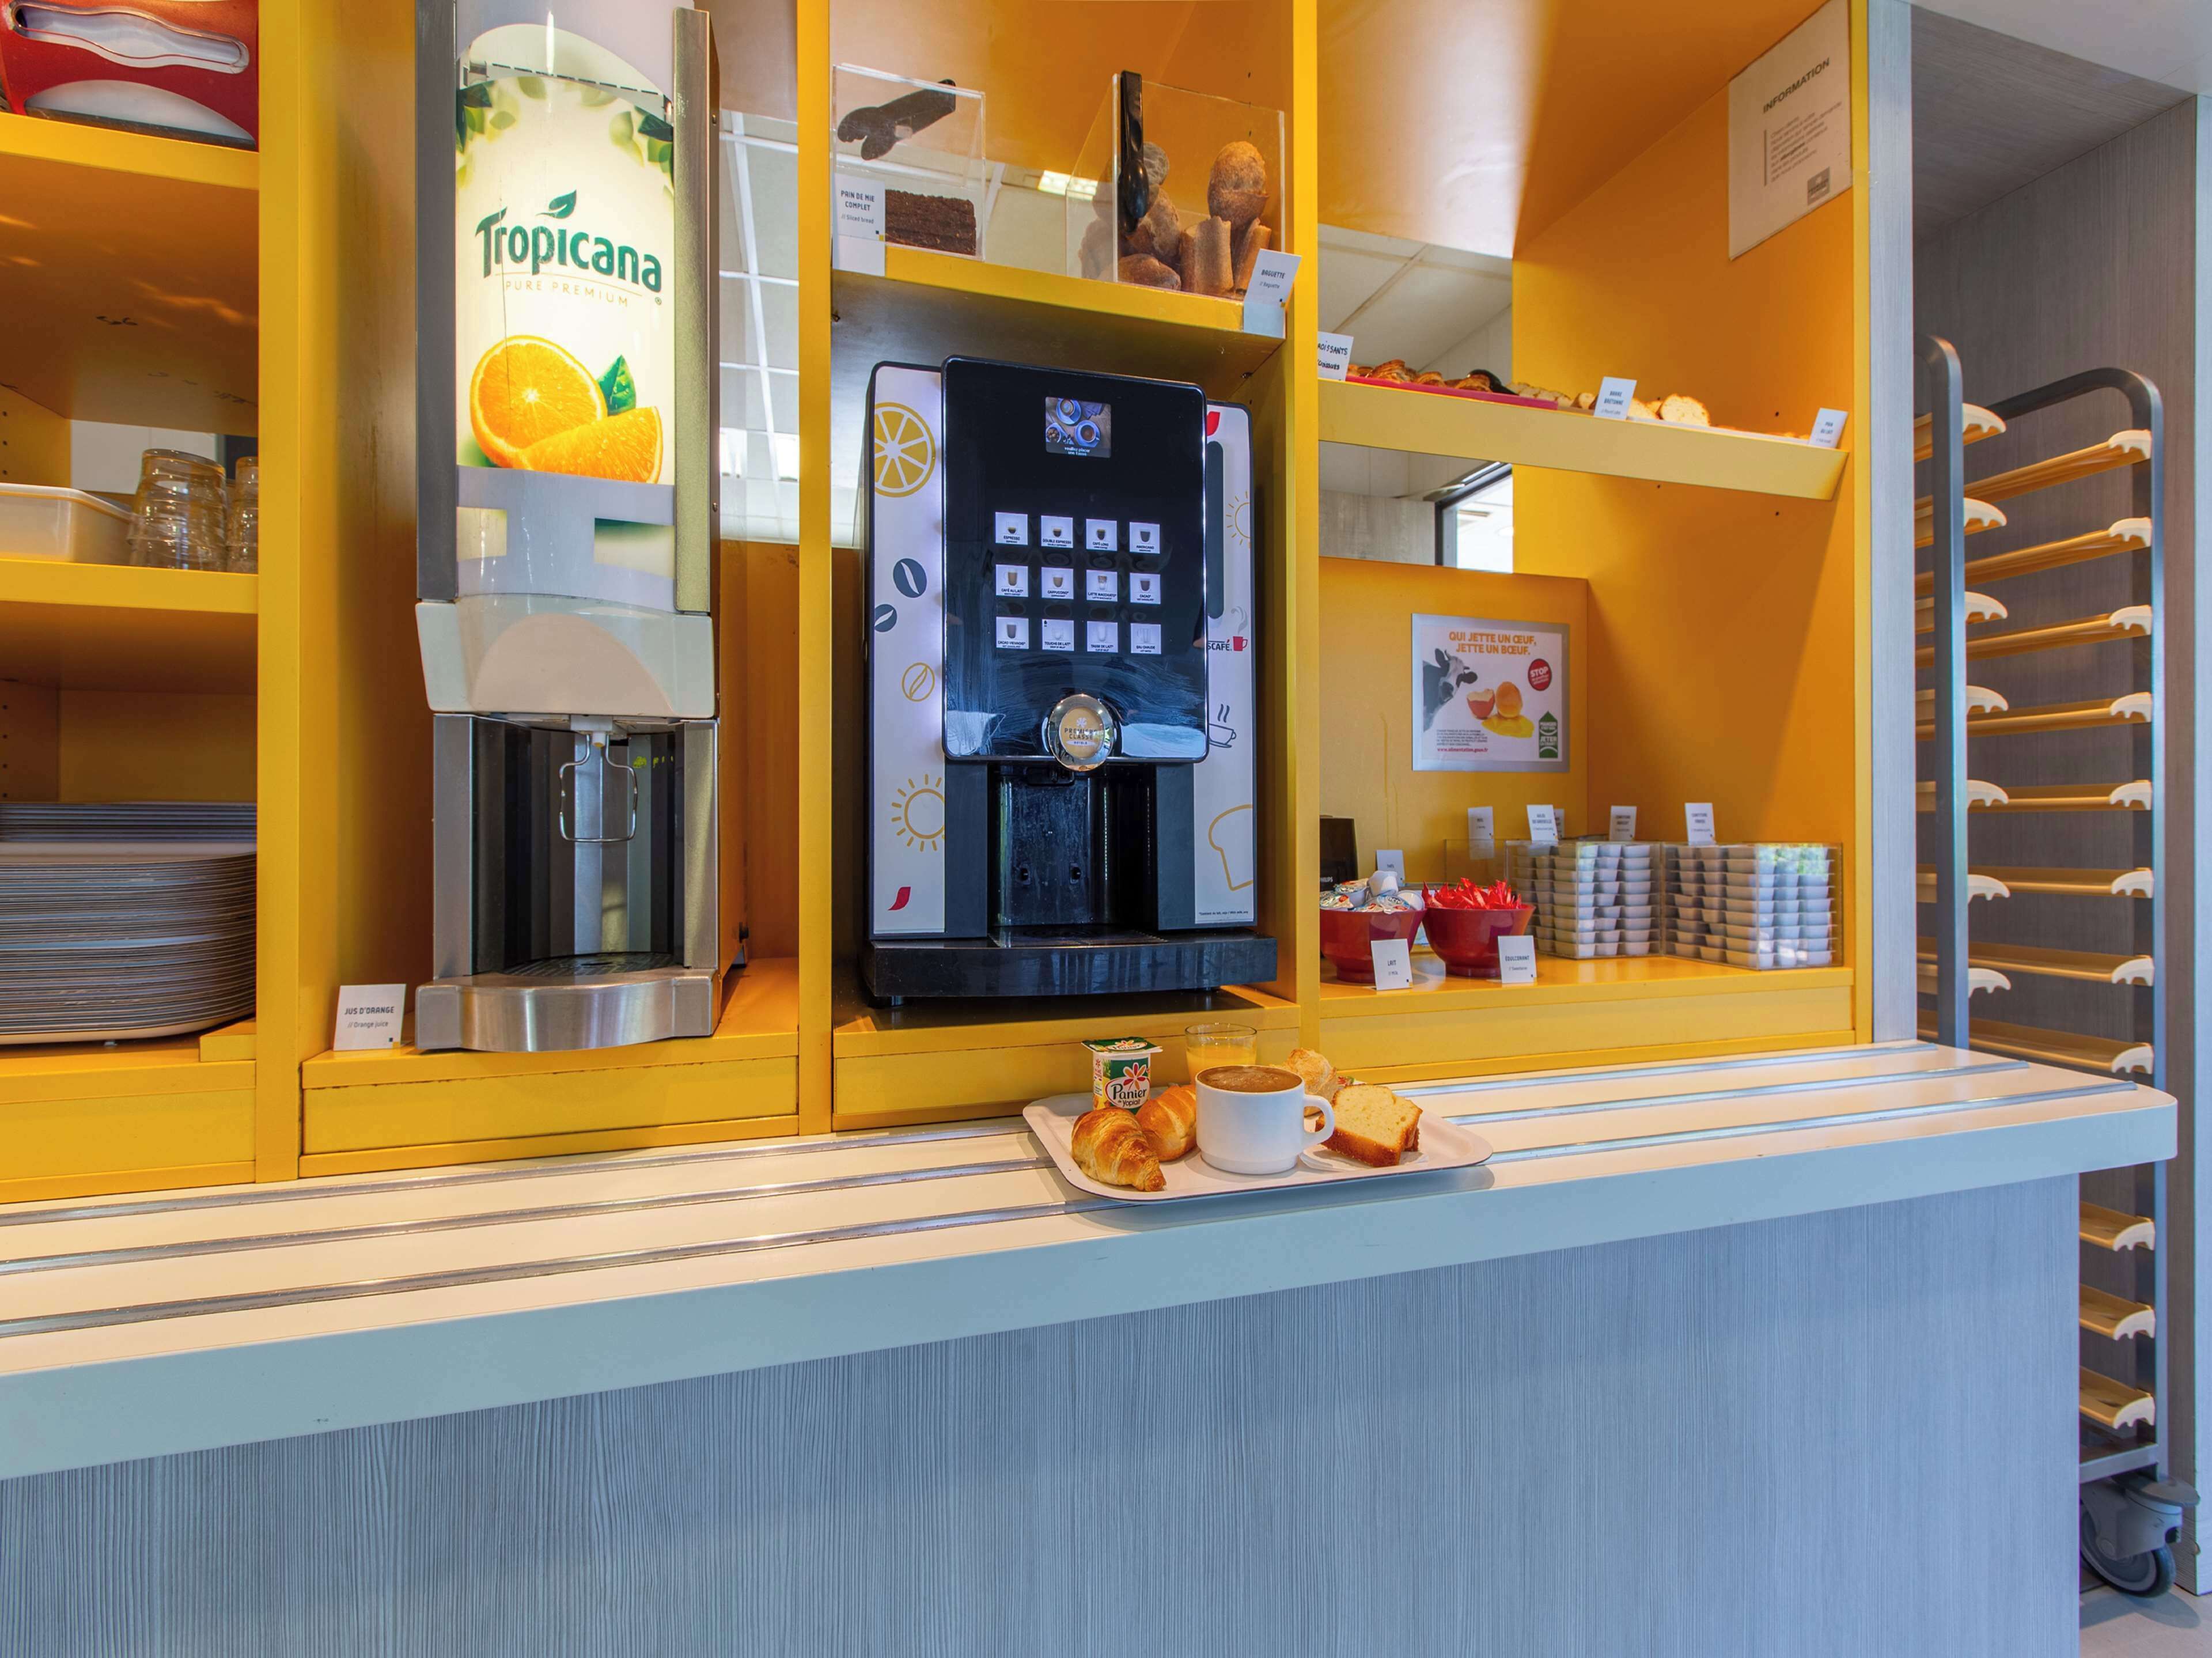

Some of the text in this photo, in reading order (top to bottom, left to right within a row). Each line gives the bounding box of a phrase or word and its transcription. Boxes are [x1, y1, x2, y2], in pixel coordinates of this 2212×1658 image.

[1763, 57, 1830, 113] INFORMATION
[841, 190, 875, 202] PAIN DE MIE
[845, 201, 870, 211] COMPLET
[475, 206, 661, 293] Tropicana
[1262, 269, 1285, 279] BAGUETTE
[505, 281, 628, 307] PURE PREMIUM
[1318, 340, 1348, 355] ROISSANTS
[1449, 631, 1465, 641] QUI
[1468, 632, 1495, 642] JETTE
[1498, 634, 1510, 643] UN
[1456, 643, 1530, 655] JETTE UN BŒUF.
[1531, 666, 1548, 678] STOP
[344, 1007, 358, 1015] JUS
[1111, 1083, 1147, 1100] Panier
[1122, 1099, 1141, 1107] Yoplait
